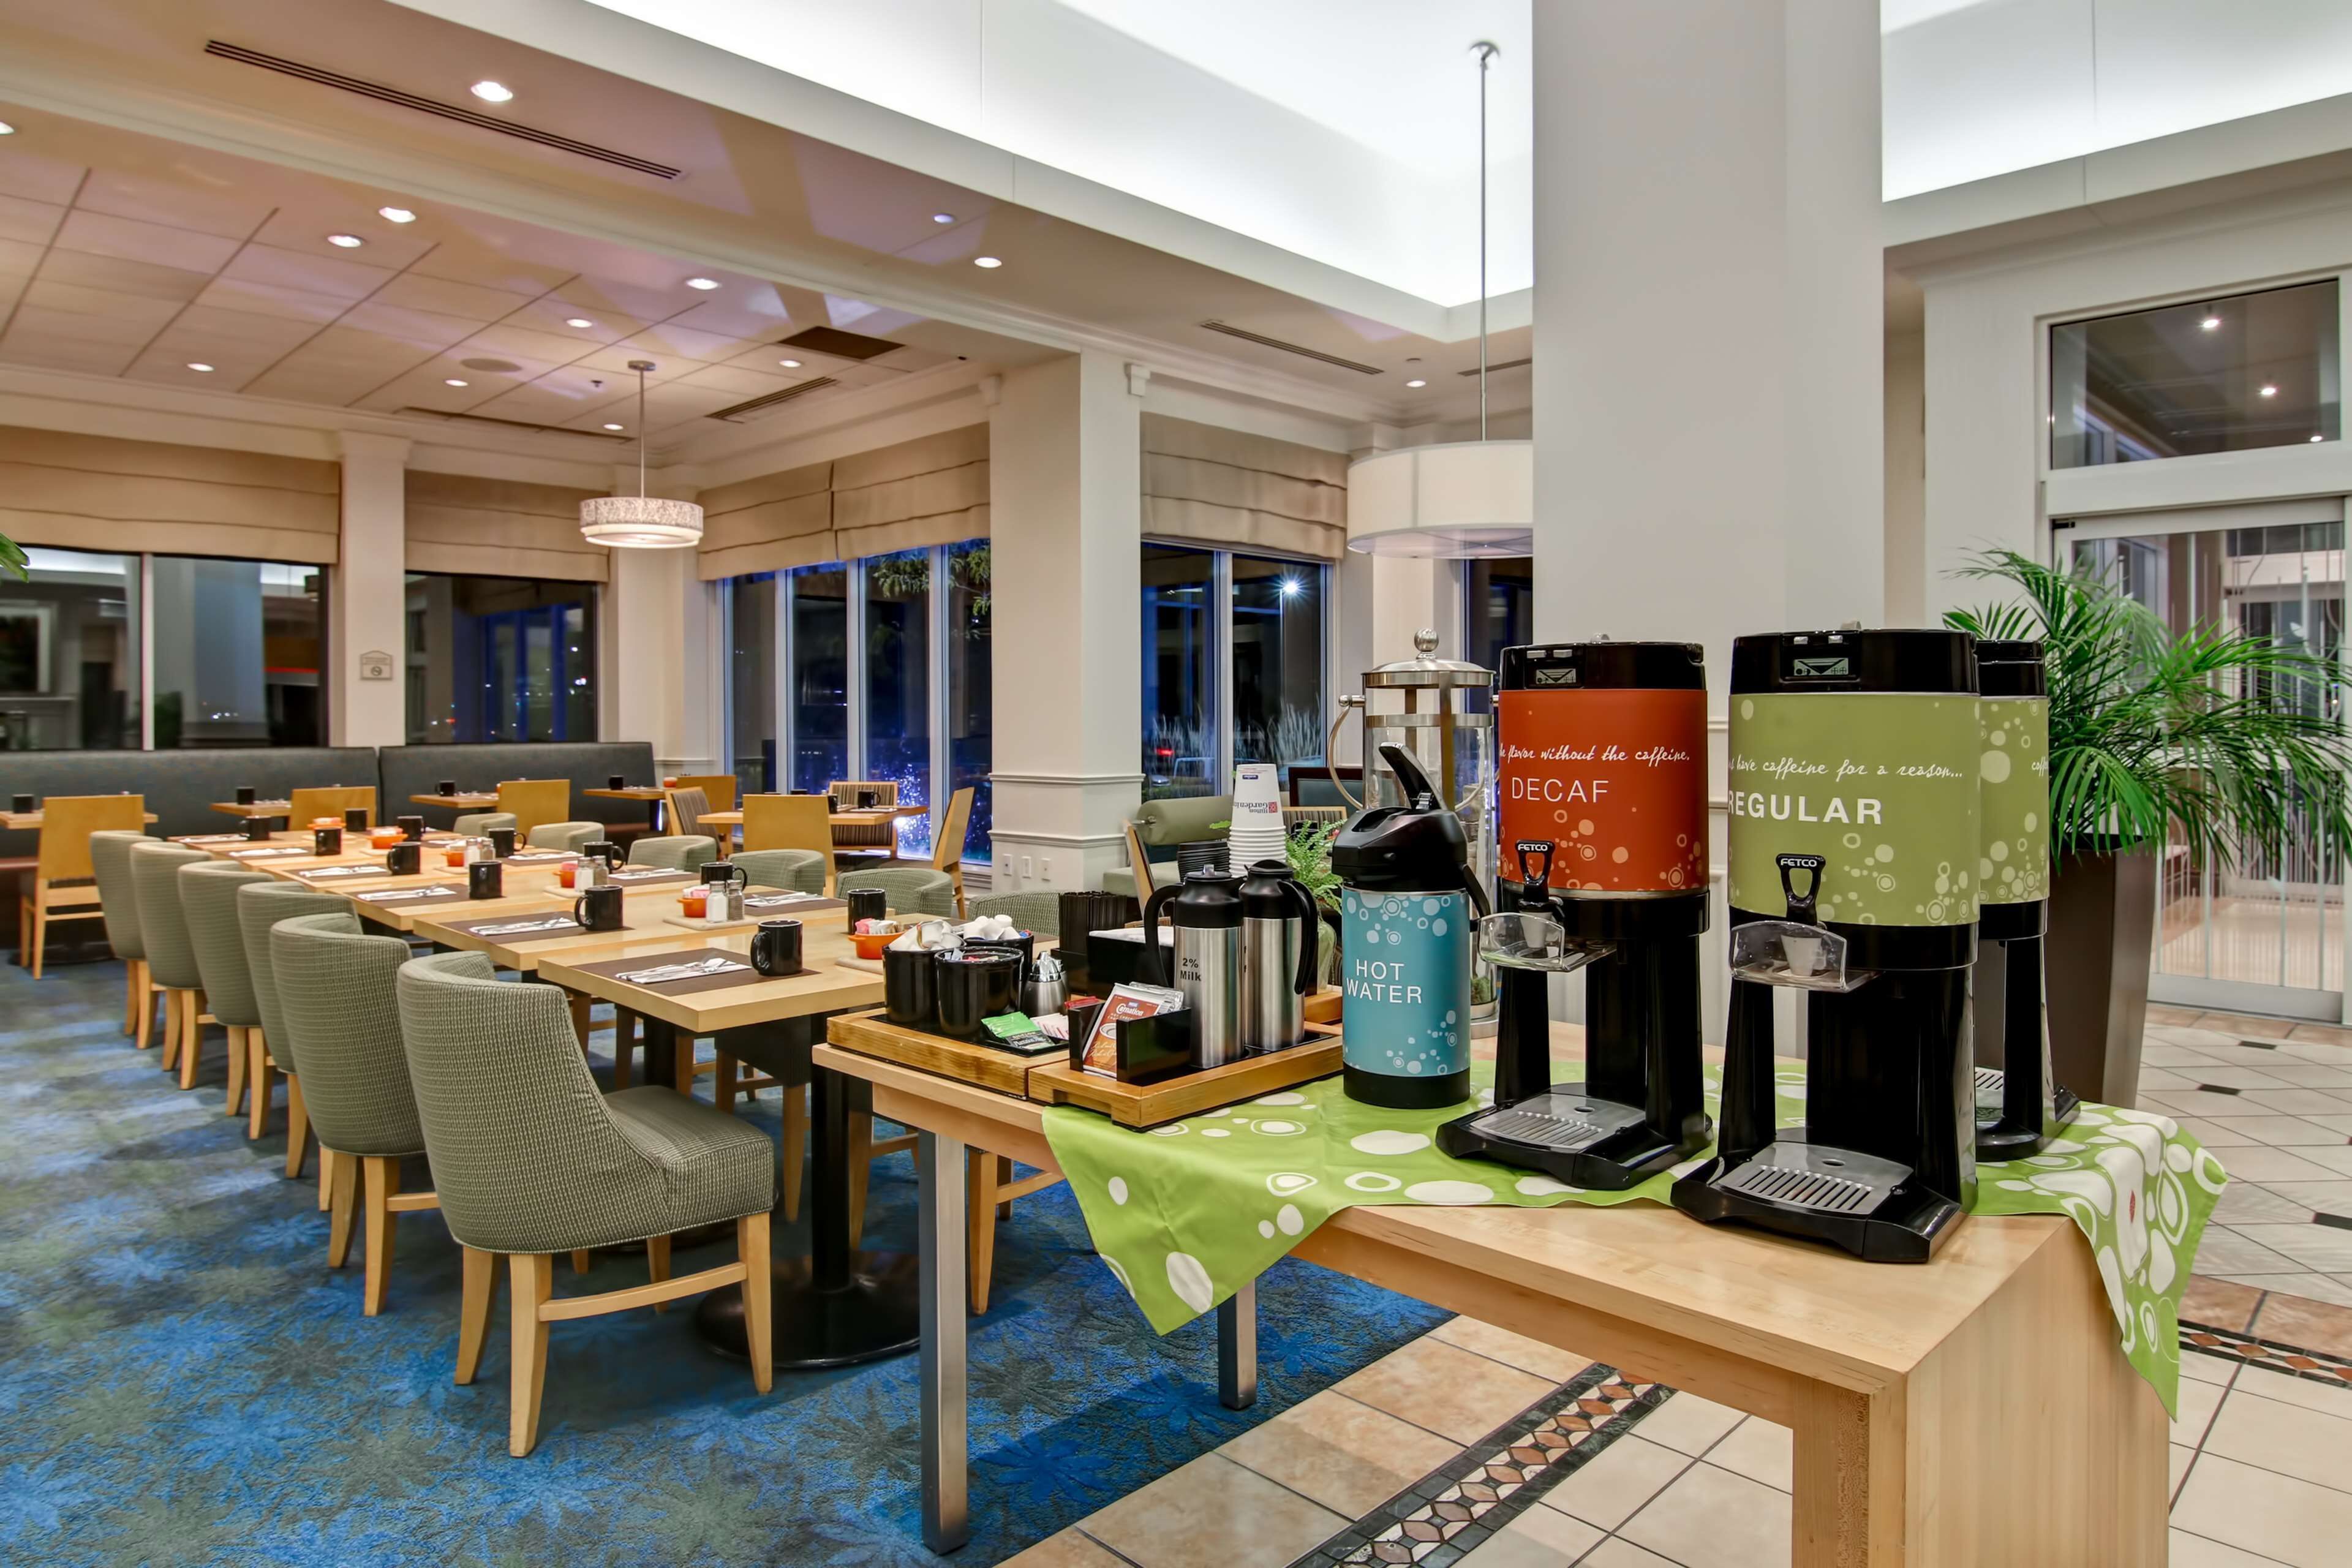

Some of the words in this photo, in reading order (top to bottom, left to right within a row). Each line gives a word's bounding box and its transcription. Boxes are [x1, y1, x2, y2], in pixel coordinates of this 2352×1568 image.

[1540, 745, 1596, 761] without
[1601, 745, 1627, 761] the
[1736, 754, 1757, 771] have
[1763, 757, 1828, 780] caffeine
[1836, 759, 1868, 782] for
[1877, 765, 1888, 775] a
[1512, 777, 1609, 803] DECAF
[1728, 790, 1882, 825] REGULAR
[1781, 858, 1817, 867] FETCO
[1183, 958, 1199, 968] 2%
[1356, 959, 1404, 981] HOT
[1180, 970, 1201, 981] Milk
[1346, 977, 1422, 1004] WATER
